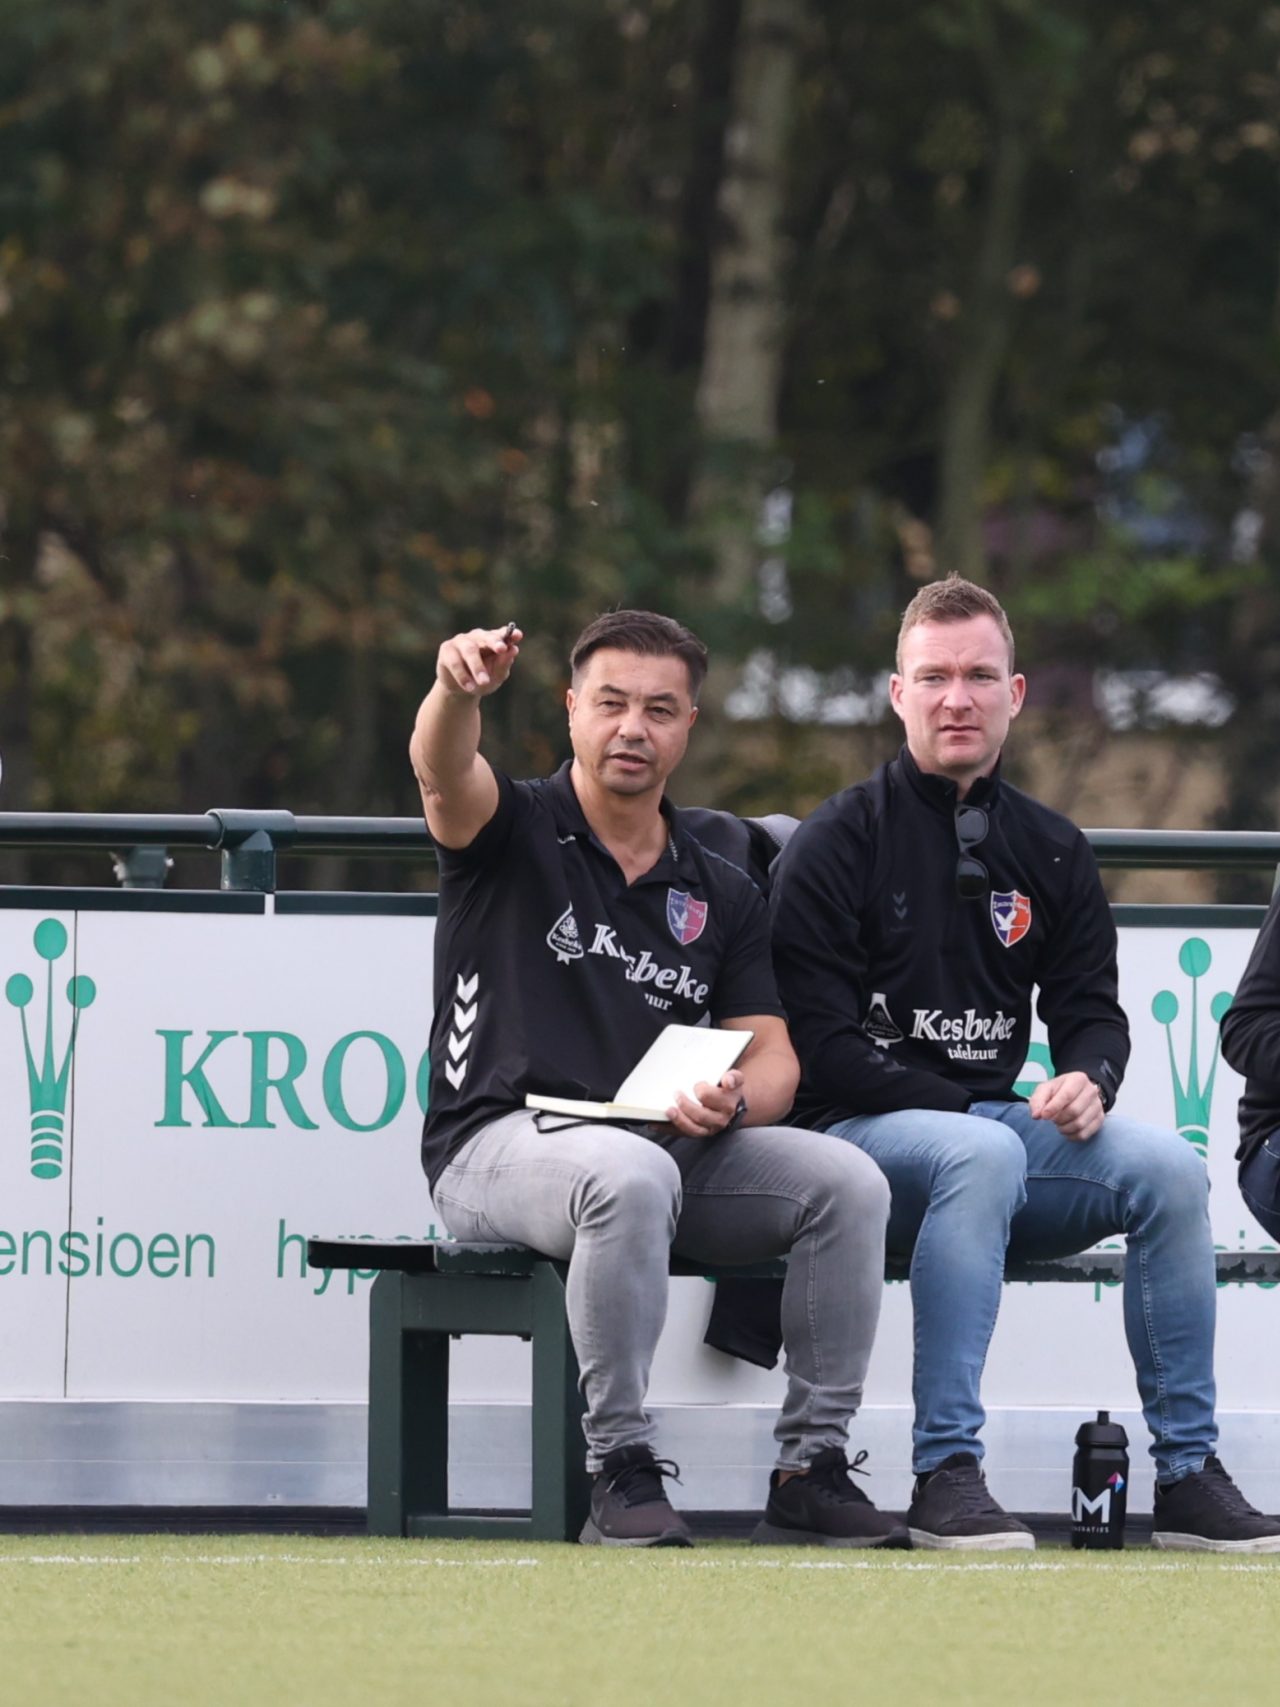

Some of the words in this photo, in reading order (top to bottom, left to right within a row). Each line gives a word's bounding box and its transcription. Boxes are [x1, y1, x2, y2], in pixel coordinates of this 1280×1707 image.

[909, 1008, 1017, 1041] Kesbeke
[948, 1043, 999, 1060] tafelzuur
[154, 1029, 430, 1132] KRO
